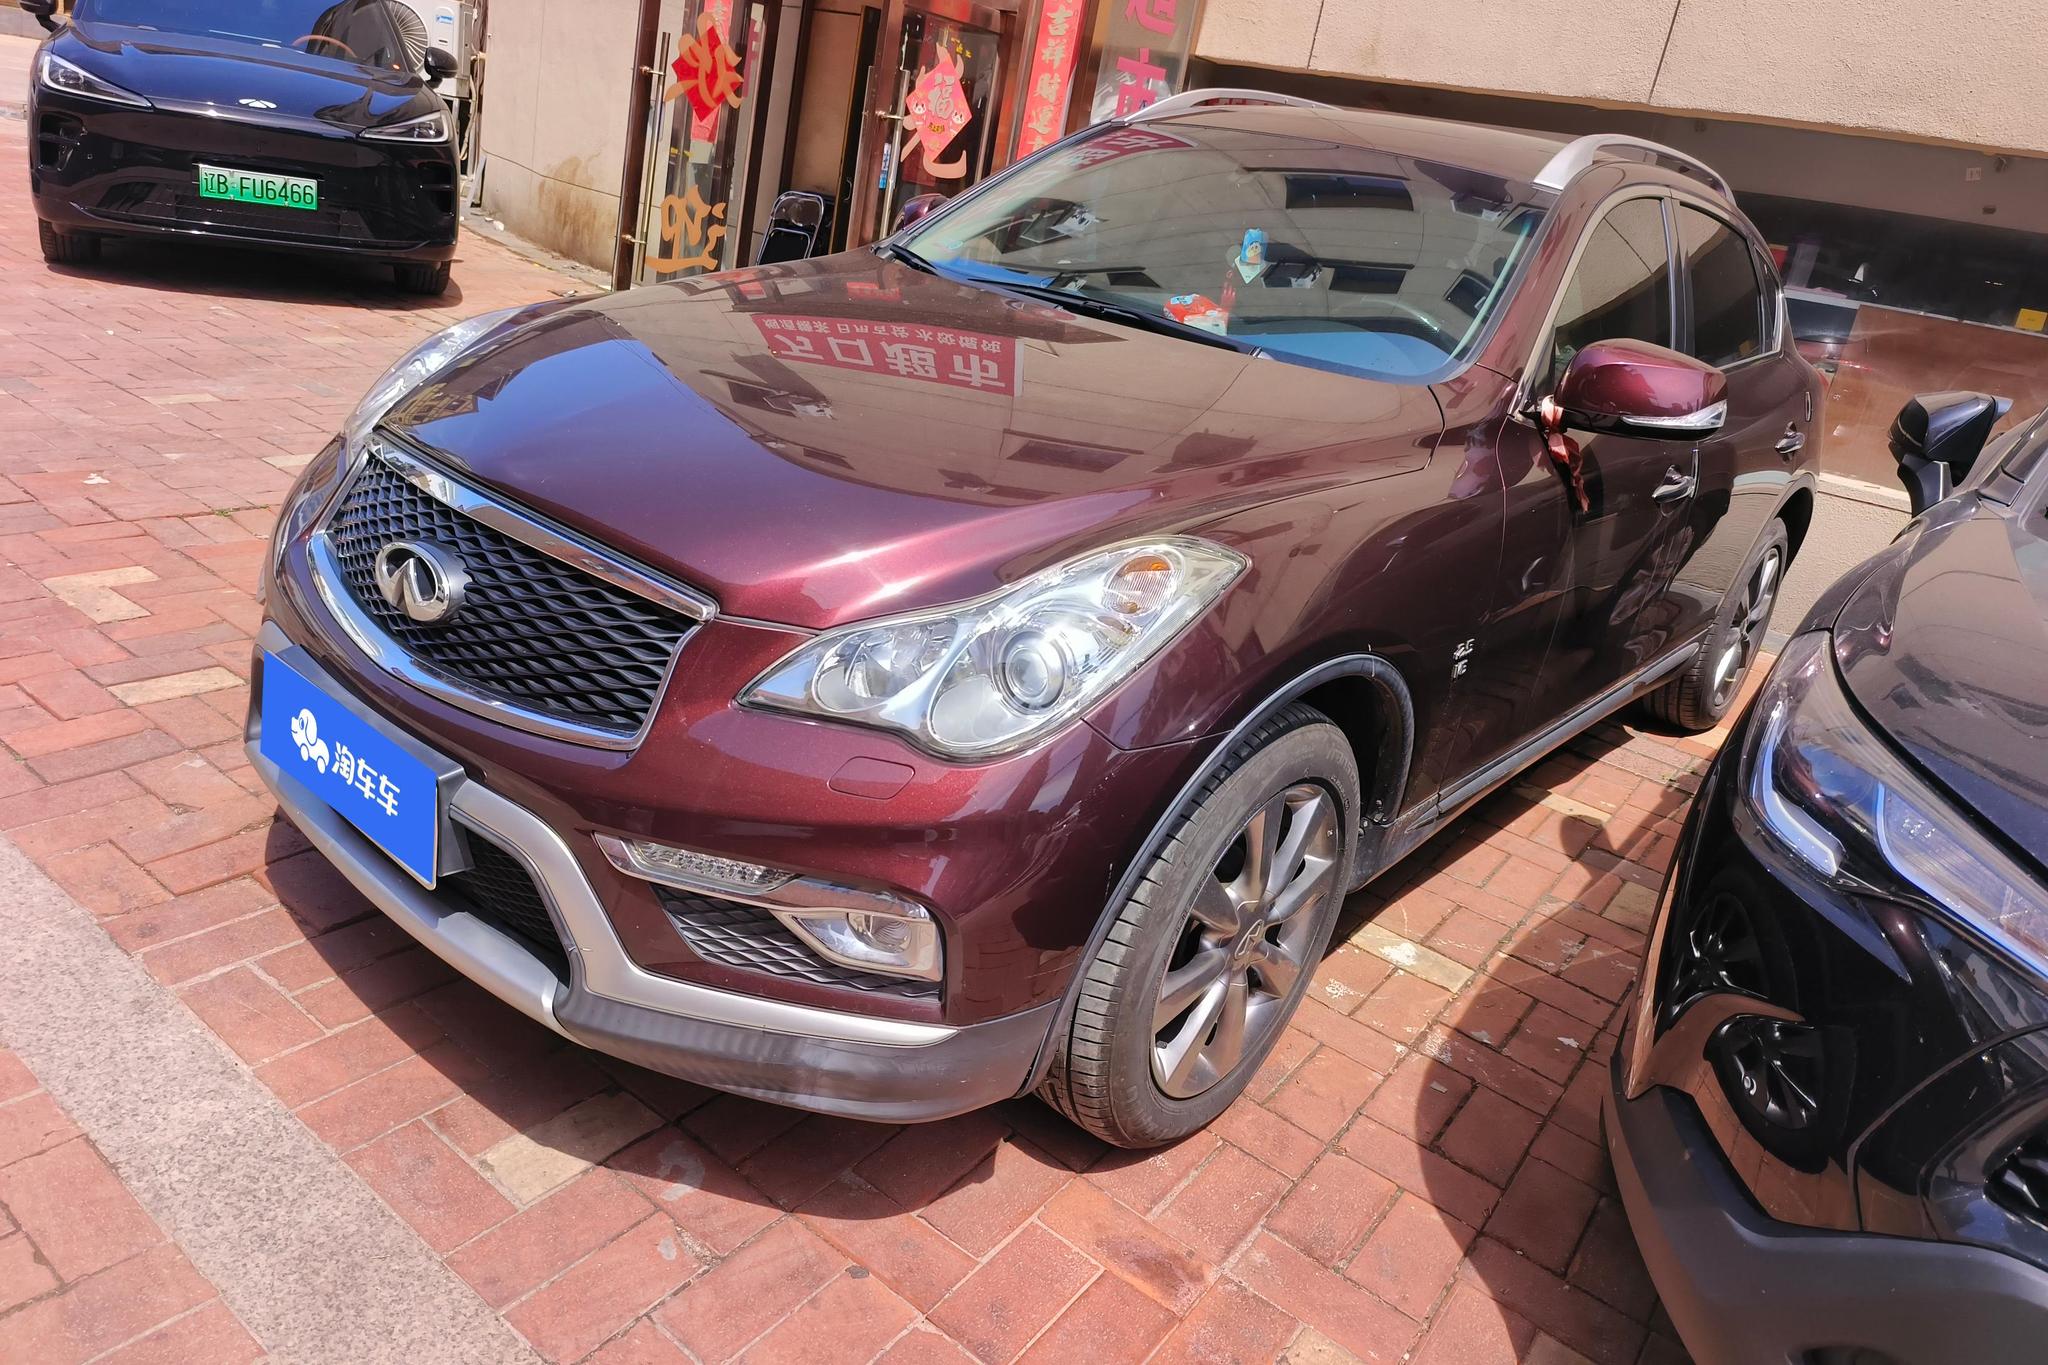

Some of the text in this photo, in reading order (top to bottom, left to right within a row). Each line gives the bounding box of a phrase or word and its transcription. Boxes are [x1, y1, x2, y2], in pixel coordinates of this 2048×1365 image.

[928, 73, 956, 120] 福
[203, 172, 314, 205] 辽B FU6466
